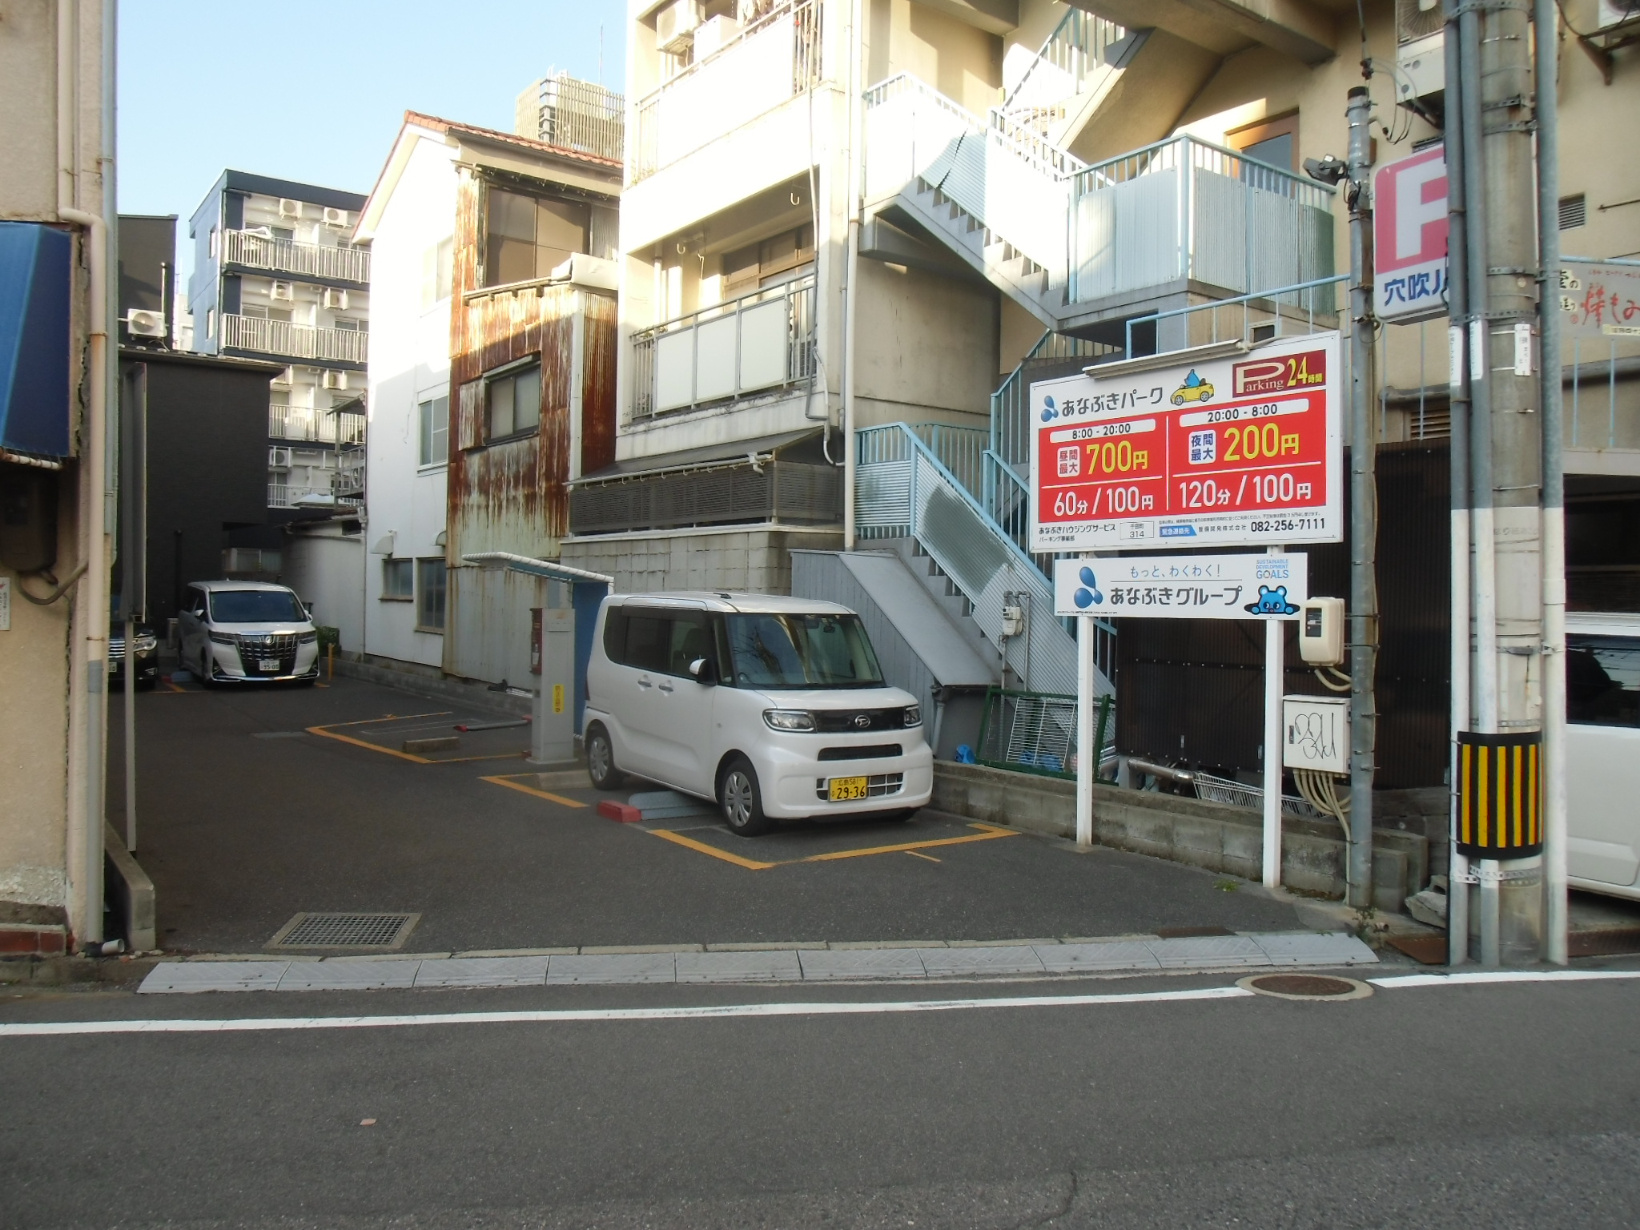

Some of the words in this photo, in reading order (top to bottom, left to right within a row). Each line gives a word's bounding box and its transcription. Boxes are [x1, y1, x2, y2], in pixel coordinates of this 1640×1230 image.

[1236, 362, 1285, 393] Parking
[1062, 387, 1163, 417] あなぶきパーク
[1207, 408, 1239, 422] 20:00
[1251, 403, 1278, 417] 8:00
[1072, 428, 1093, 440] 8:00
[1103, 423, 1131, 436] 20:00
[1191, 433, 1213, 448] 夜間
[1223, 422, 1299, 462] 200円
[1059, 448, 1078, 461] 昼間
[1086, 440, 1148, 475] 700円
[1191, 448, 1213, 461] 最大
[1059, 461, 1078, 474] 最大
[1179, 479, 1230, 509] 120分
[1253, 472, 1311, 503] 100円
[1054, 491, 1088, 517] 60分
[1106, 486, 1154, 513] 100円
[1039, 524, 1116, 535] あなぶきハウジングサービス
[1251, 518, 1326, 532] 082-256-7111
[1256, 570, 1290, 579] GOALS
[1110, 585, 1243, 606] あなぶきグループ
[837, 786, 865, 799] 29-36
